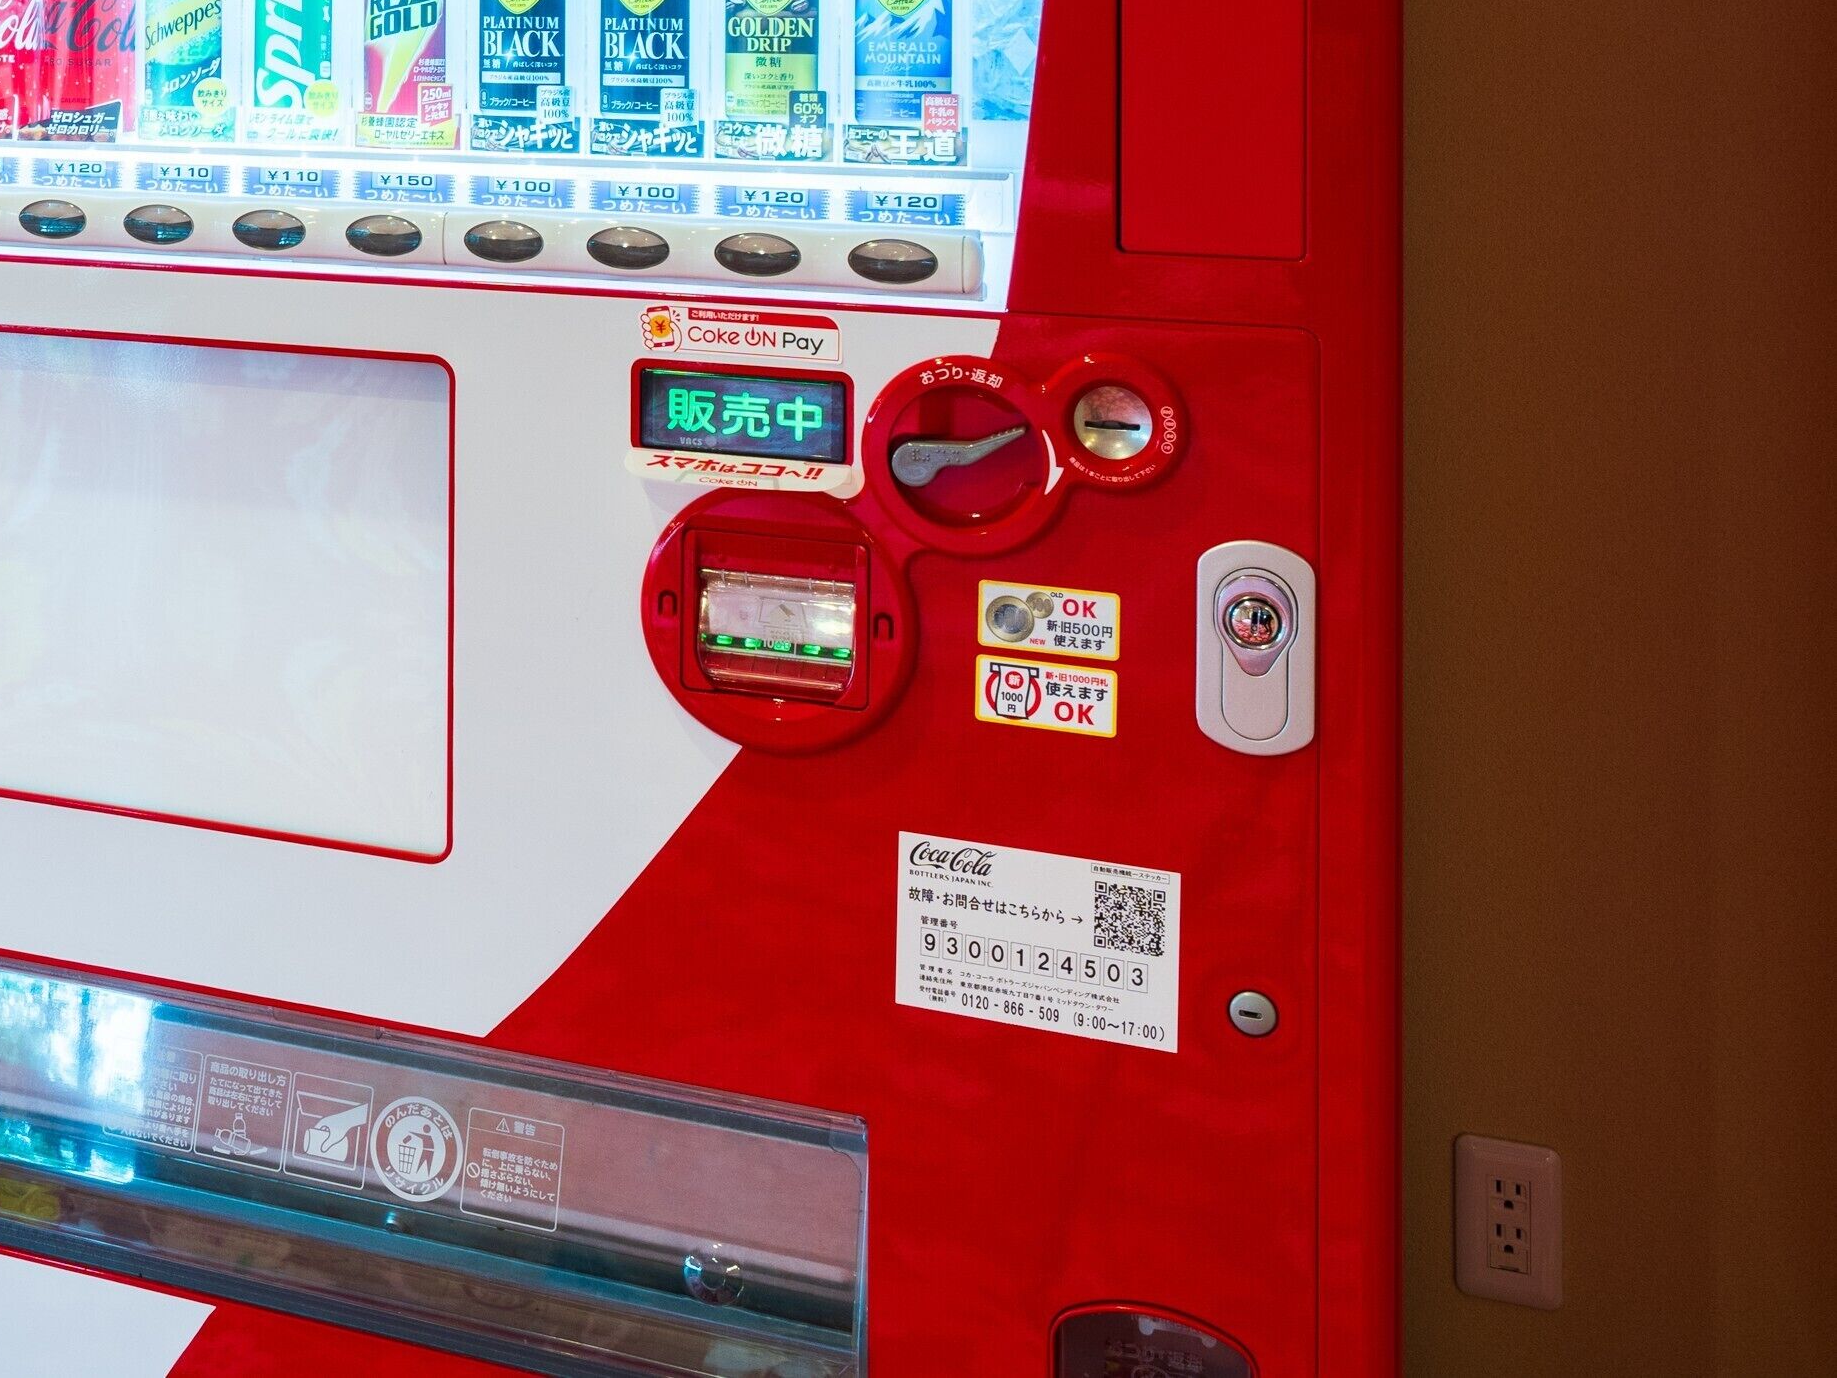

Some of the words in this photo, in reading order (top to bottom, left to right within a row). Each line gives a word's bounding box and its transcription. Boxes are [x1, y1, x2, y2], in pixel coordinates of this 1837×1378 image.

[483, 16, 560, 30] PLATINUM
[728, 17, 815, 38] GOLDEN
[483, 31, 561, 58] BLACK
[746, 37, 792, 53] DRIP
[868, 41, 938, 53] EMERALD
[865, 52, 942, 65] MOUNTAIN
[54, 163, 103, 174] ¥120
[268, 171, 319, 182] ¥110
[617, 186, 675, 199] ¥100
[876, 195, 937, 208] ¥120
[687, 325, 742, 347] Coke
[745, 325, 778, 349] ON
[782, 331, 824, 356] Pay
[919, 363, 1004, 389] おつり・返却
[667, 387, 823, 443] 販売中
[1062, 598, 1097, 619] OK
[1054, 635, 1105, 651] 使えます
[1046, 682, 1108, 701] 使えます
[1054, 701, 1095, 725] OK
[910, 840, 997, 877] Coca-Cola
[910, 870, 950, 882] BOTTLERS
[952, 876, 976, 885] JAPAN
[920, 916, 958, 930] 管理番号
[210, 1060, 287, 1088] 商品の取り出し方
[383, 1102, 454, 1142] のんだあとは
[383, 1165, 447, 1194] リサイクル
